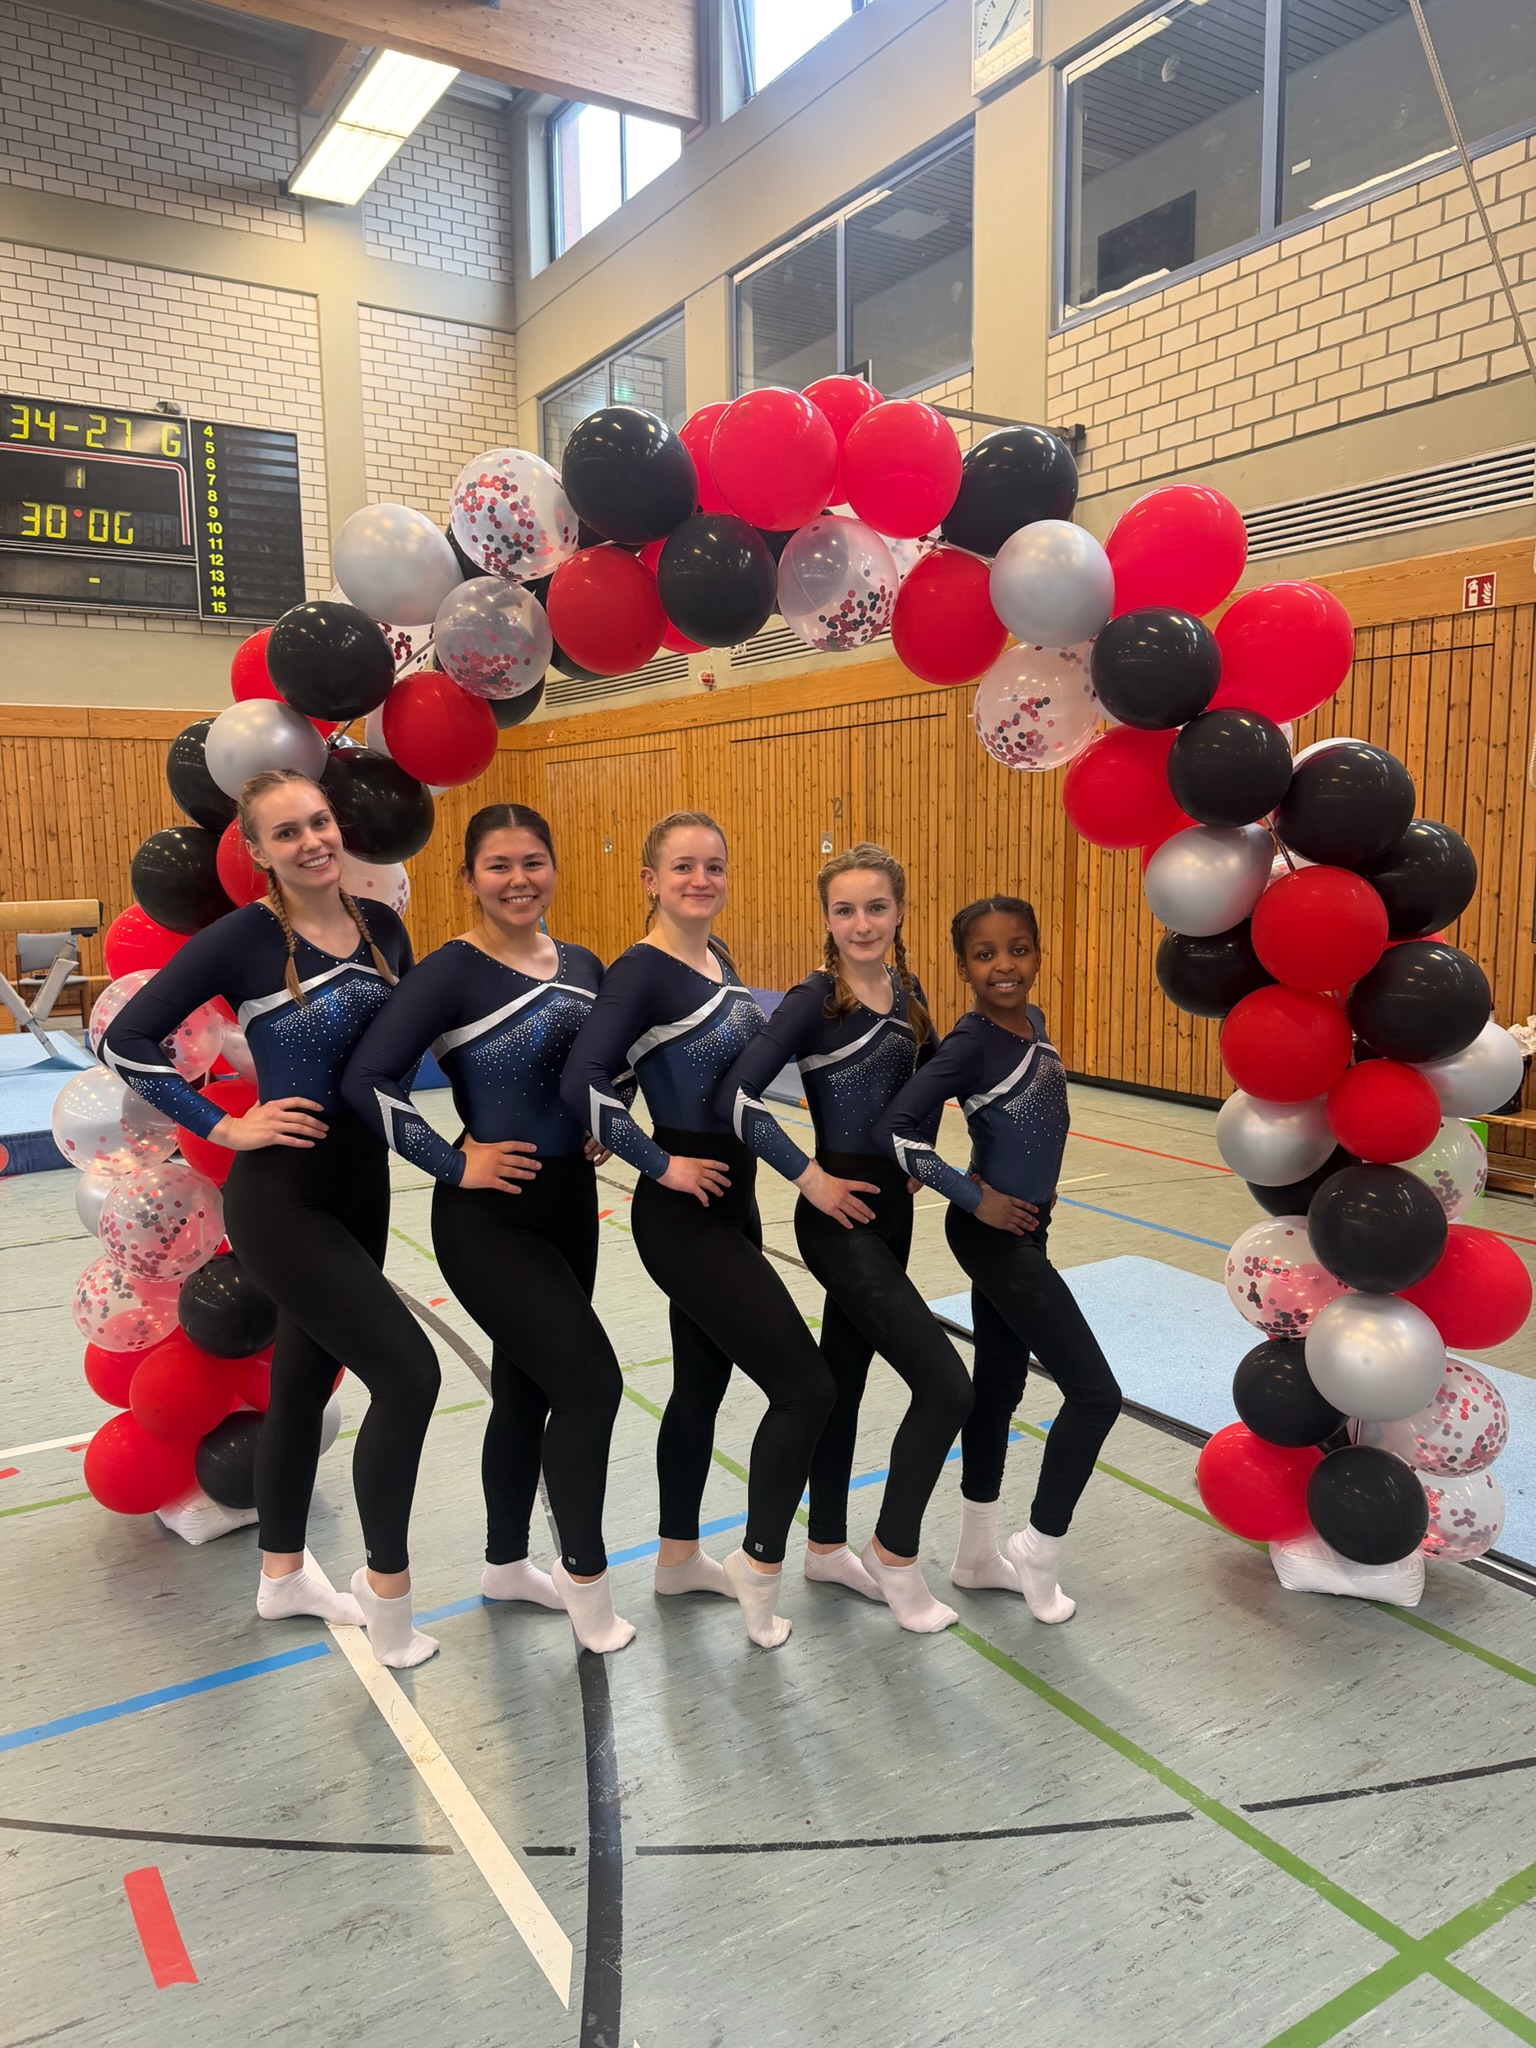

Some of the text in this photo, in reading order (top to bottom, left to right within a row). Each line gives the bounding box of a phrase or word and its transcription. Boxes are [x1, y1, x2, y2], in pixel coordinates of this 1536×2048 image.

[203, 425, 214, 438] 4
[161, 425, 181, 457] G
[204, 441, 215, 454] 5
[205, 457, 216, 470] 6
[206, 474, 216, 486] 7
[207, 489, 217, 502] 8
[207, 505, 218, 518] 9
[207, 522, 222, 534] 10
[208, 538, 223, 550] 11
[209, 554, 224, 566] 12
[209, 570, 225, 582] 13
[210, 586, 226, 598] 14
[211, 602, 227, 614] 15
